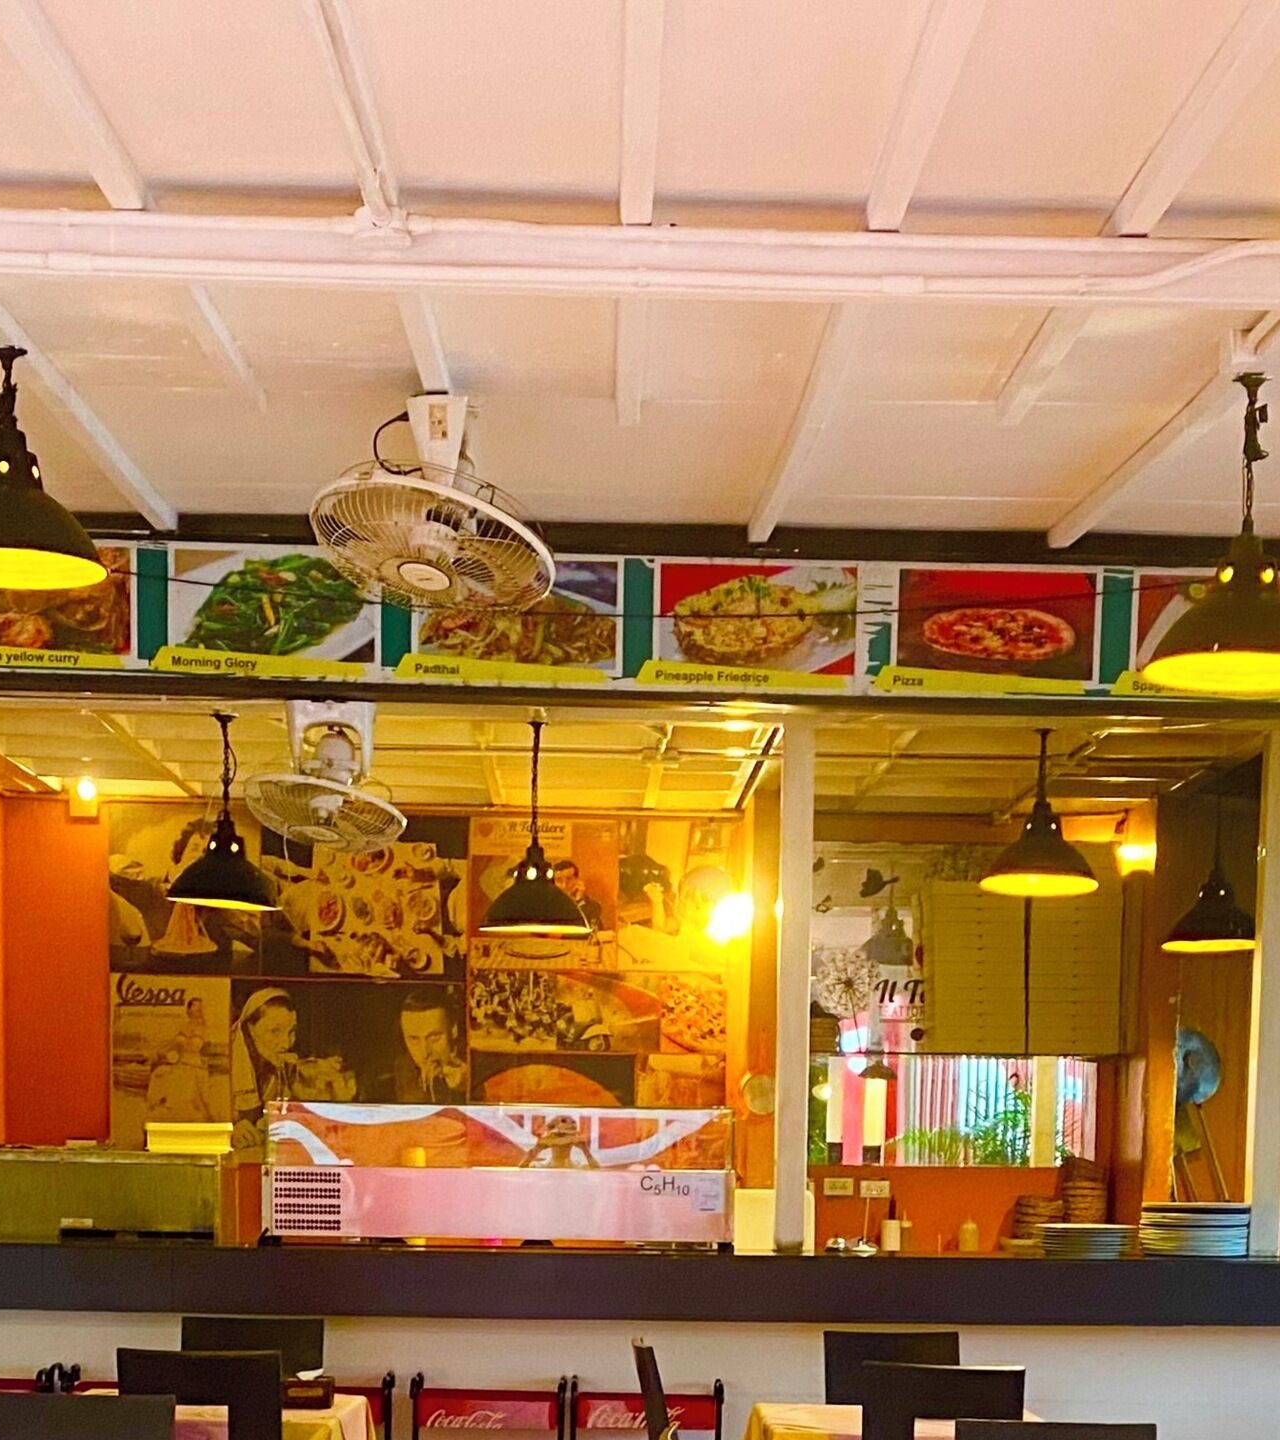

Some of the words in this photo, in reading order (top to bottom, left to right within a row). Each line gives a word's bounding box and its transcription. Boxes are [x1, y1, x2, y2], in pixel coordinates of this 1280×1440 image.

[6, 651, 45, 664] yellow
[48, 653, 80, 665] curry
[171, 655, 221, 669] Morning
[224, 658, 257, 671] Glory
[414, 662, 460, 675] Padthai
[655, 669, 714, 684] Pineapple
[717, 670, 770, 683] Friedrice
[892, 675, 924, 686] Pizza
[115, 973, 186, 1006] Vespa
[425, 1409, 507, 1429] Coca-Cola
